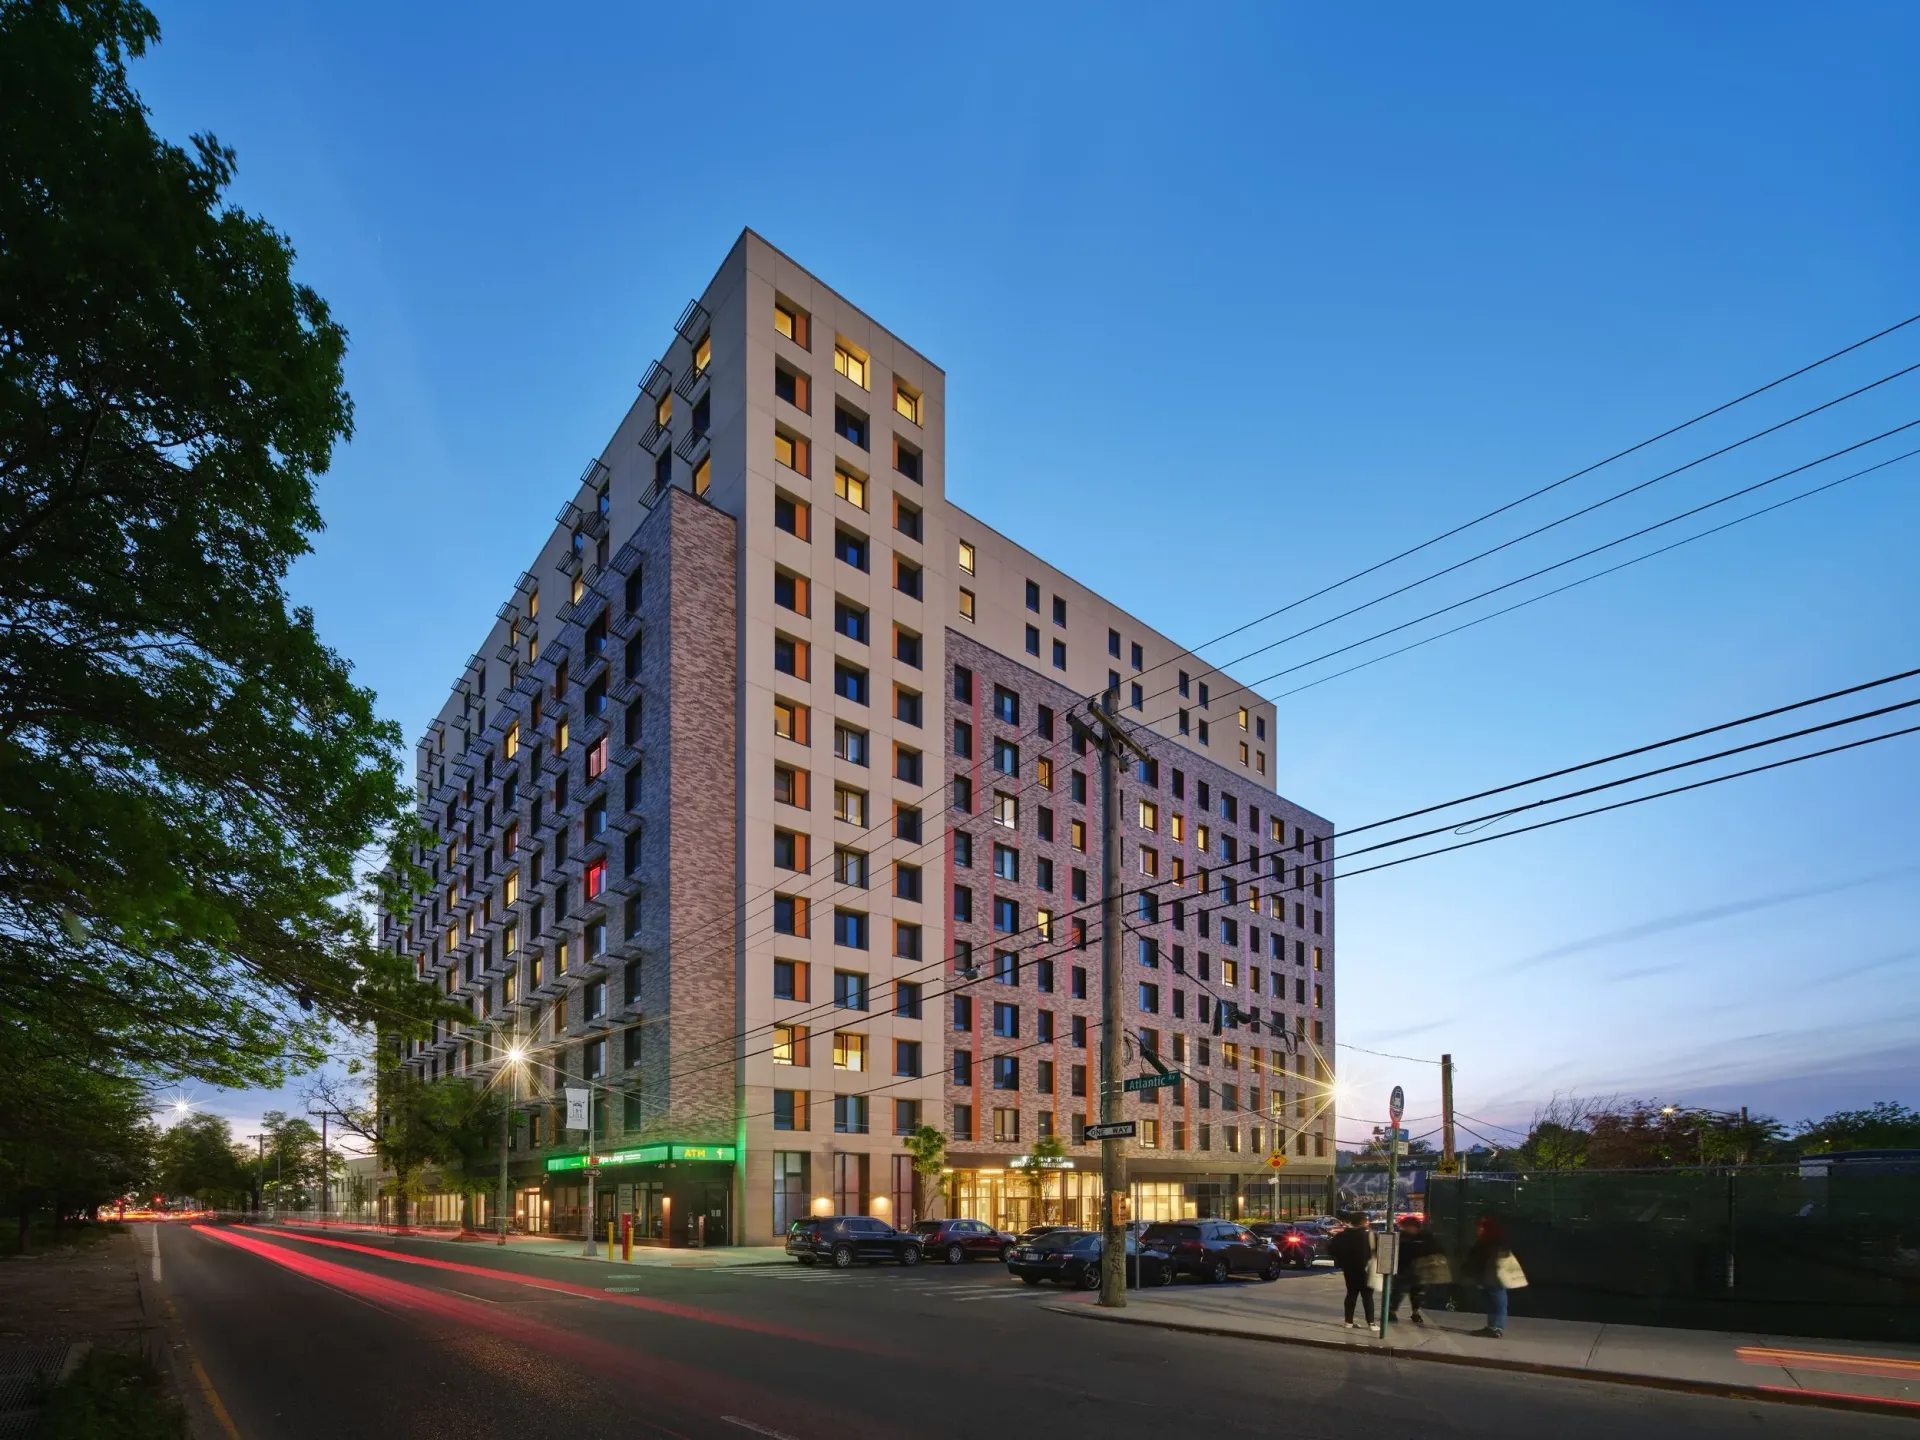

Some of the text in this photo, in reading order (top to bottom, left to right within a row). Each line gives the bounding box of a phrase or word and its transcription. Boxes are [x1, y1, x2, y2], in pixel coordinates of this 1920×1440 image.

[1129, 1076, 1166, 1090] Atlantic
[1090, 1126, 1129, 1136] ONE WAY
[684, 1148, 706, 1158] ATM
